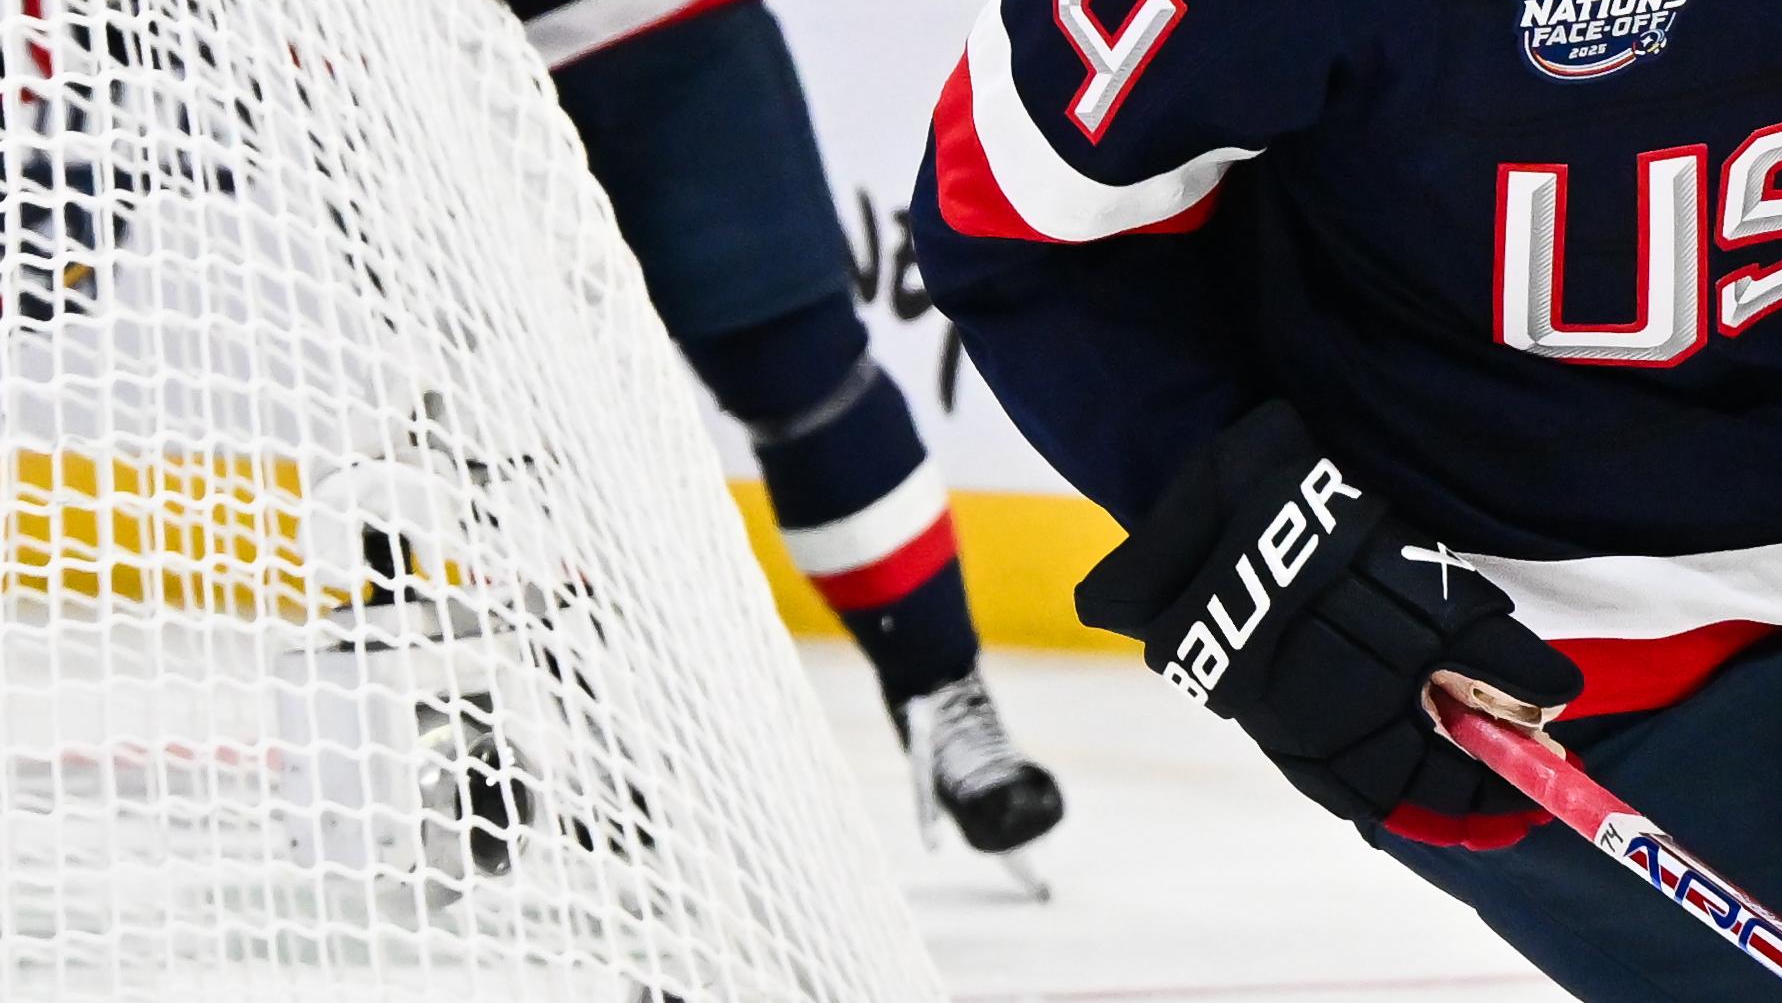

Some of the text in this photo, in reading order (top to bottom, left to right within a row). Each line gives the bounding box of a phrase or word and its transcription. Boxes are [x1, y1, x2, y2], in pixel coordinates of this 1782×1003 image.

[1532, 11, 1669, 48] FACE-OFF
[1568, 43, 1608, 60] 2025
[1600, 822, 1624, 853] 74
